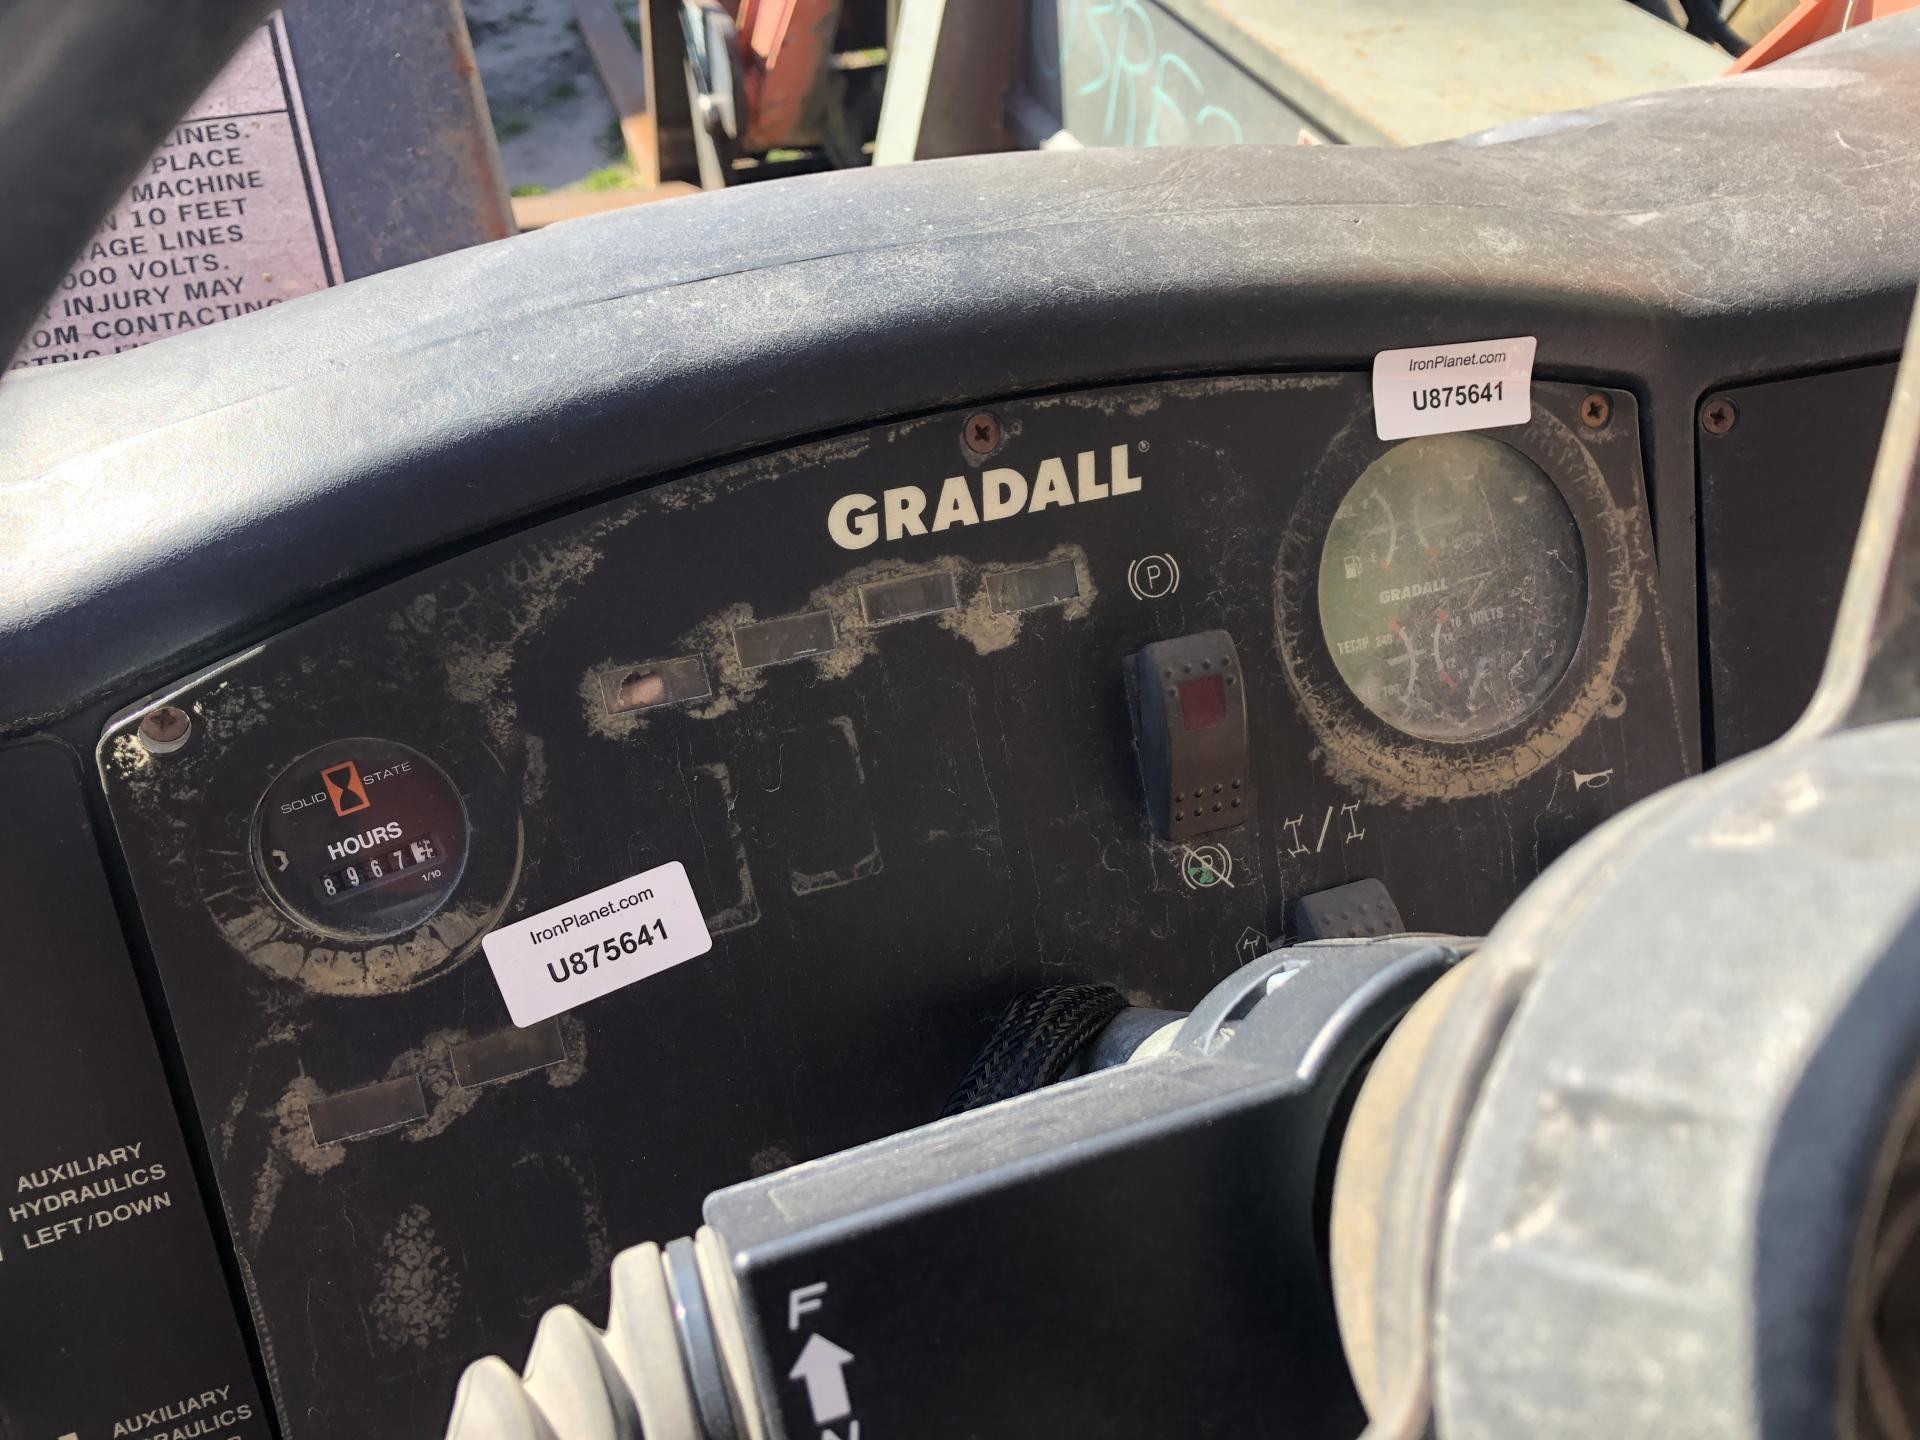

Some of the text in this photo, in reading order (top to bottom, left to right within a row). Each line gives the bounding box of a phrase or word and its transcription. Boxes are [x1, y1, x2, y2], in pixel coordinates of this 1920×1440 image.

[151, 148, 243, 174] PLACE
[131, 171, 263, 202] MACHINE
[131, 207, 167, 227] 10
[178, 198, 247, 222] FEET
[160, 224, 244, 252] LINES
[129, 254, 229, 281] VOLTS.
[64, 276, 243, 317] INJURY MAY
[1409, 352, 1506, 372] IronPlanet.com
[1413, 381, 1503, 411] U875641
[1379, 578, 1449, 605] GRADALL
[1469, 607, 1504, 625] VOLTS
[280, 762, 412, 814] SOLID STATE
[327, 821, 403, 860] HOURS
[422, 869, 442, 882] 1/10
[530, 888, 655, 945] IronPlanet.com
[546, 918, 669, 983] U875641
[17, 1142, 142, 1193] AUXILIARY
[8, 1163, 167, 1223] HYDRAULICS
[113, 1385, 230, 1439] AUXILIARY
